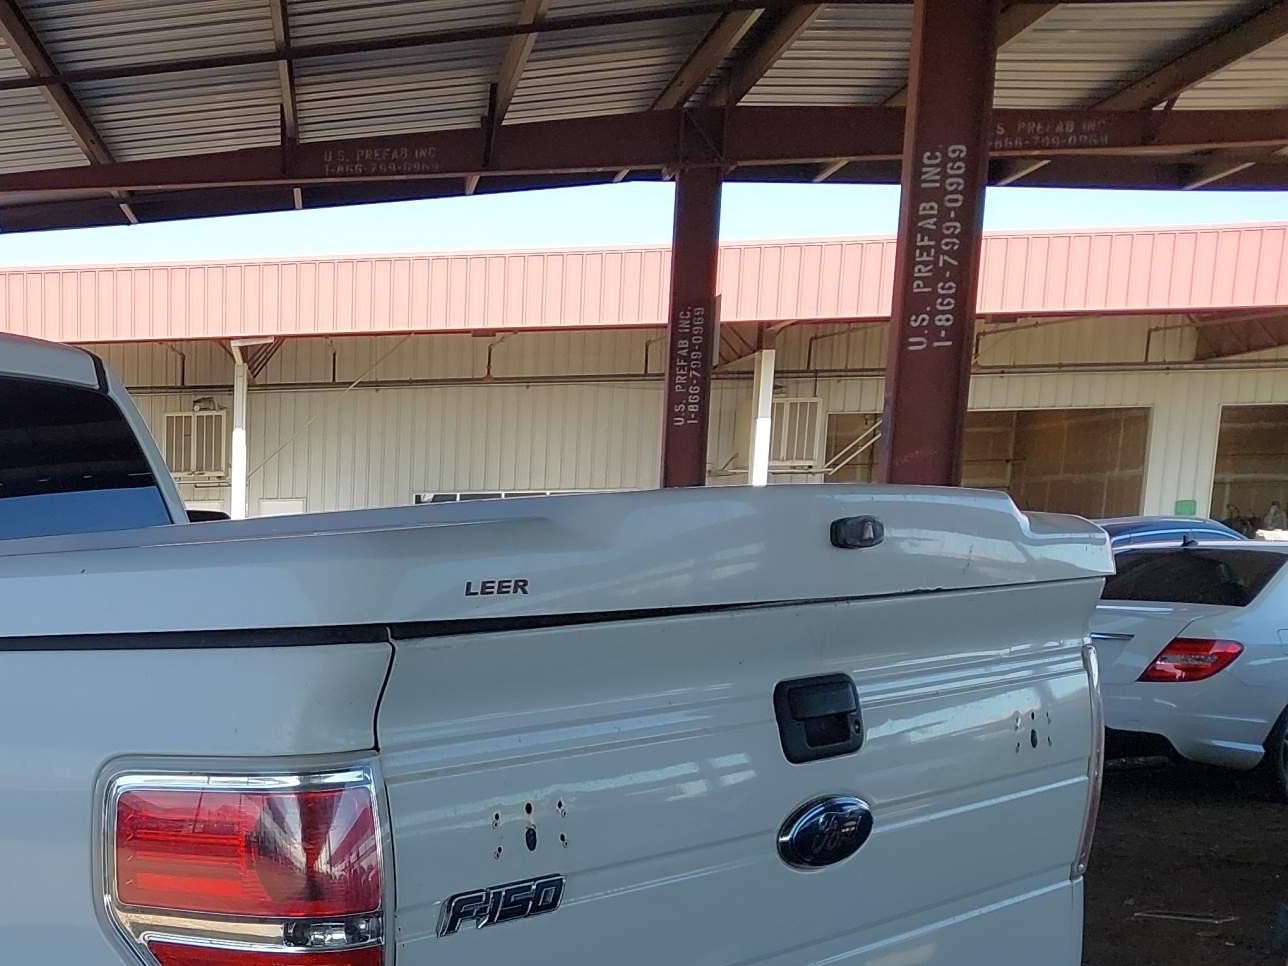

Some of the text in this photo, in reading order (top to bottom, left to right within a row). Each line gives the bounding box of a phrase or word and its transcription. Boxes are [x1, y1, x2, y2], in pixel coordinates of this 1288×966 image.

[356, 148, 408, 161] PREFAB
[913, 201, 938, 293] PREFAB
[932, 144, 966, 348] 1-866-799-0969
[673, 306, 692, 426] U.S. PREFAB INC.
[687, 307, 705, 424] 1-866-799-0969
[907, 306, 931, 351] U.S.
[465, 579, 529, 596] LEER
